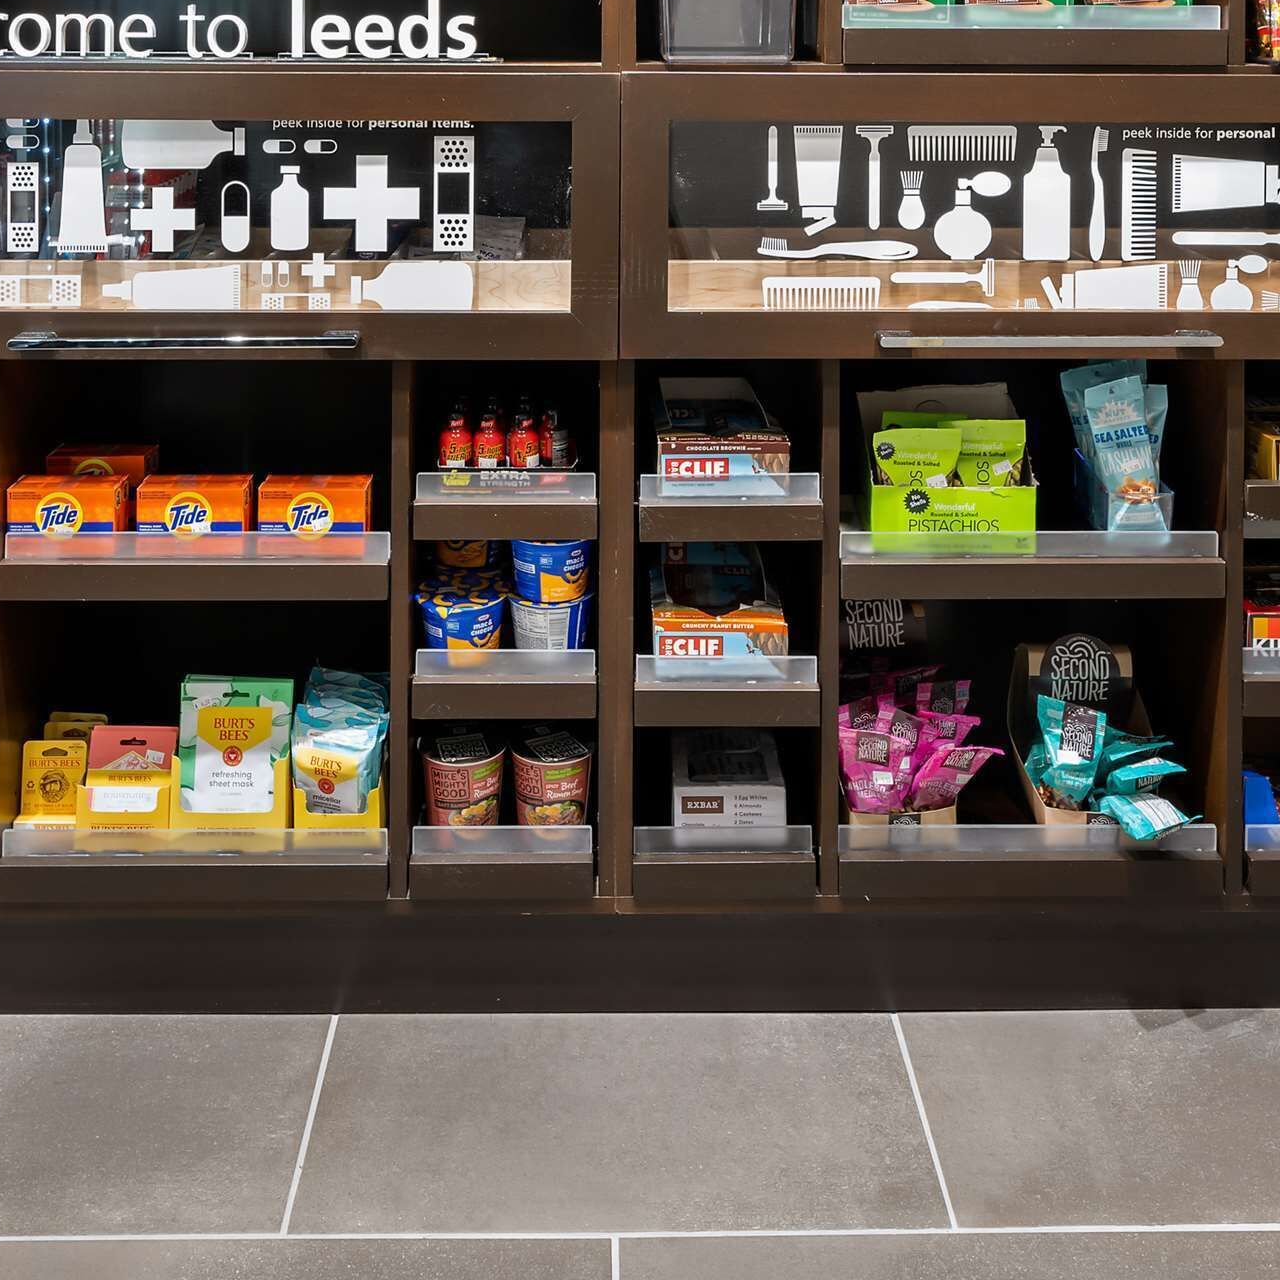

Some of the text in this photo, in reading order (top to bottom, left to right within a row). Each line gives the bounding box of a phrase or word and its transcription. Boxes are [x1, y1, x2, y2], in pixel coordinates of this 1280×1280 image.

[178, 4, 248, 58] to
[273, 120, 302, 130] peek
[307, 120, 345, 128] inside
[347, 120, 365, 128] for
[369, 120, 428, 130] personal
[1122, 128, 1151, 140] peek
[1156, 127, 1191, 138] inside
[1194, 127, 1214, 138] for
[1217, 127, 1275, 141] personal
[680, 461, 726, 478] CLIF
[933, 502, 977, 512] Wonderful
[40, 504, 78, 526] Tide
[169, 503, 208, 527] Tide
[291, 504, 330, 527] Tide
[908, 518, 1000, 534] PISTACHIOS
[845, 598, 904, 625] SECOND
[848, 622, 906, 650] NATURE
[673, 639, 719, 656] CLIF
[1050, 650, 1110, 681] SECOND
[1051, 679, 1110, 702] NATURE
[213, 717, 255, 730] BURT'S
[219, 729, 249, 741] BEES
[857, 738, 888, 753] SECOND
[28, 758, 81, 769] BURT'S BEES
[310, 756, 343, 771] BURT'S
[857, 750, 888, 763] NATURE
[211, 770, 253, 781] refreshing
[314, 767, 339, 779] BEES
[433, 768, 467, 780] MIKE'S
[209, 779, 254, 788] sheet mask
[434, 779, 468, 789] MIGHTY
[435, 787, 467, 798] GOOD
[687, 801, 720, 809] RXBAR
